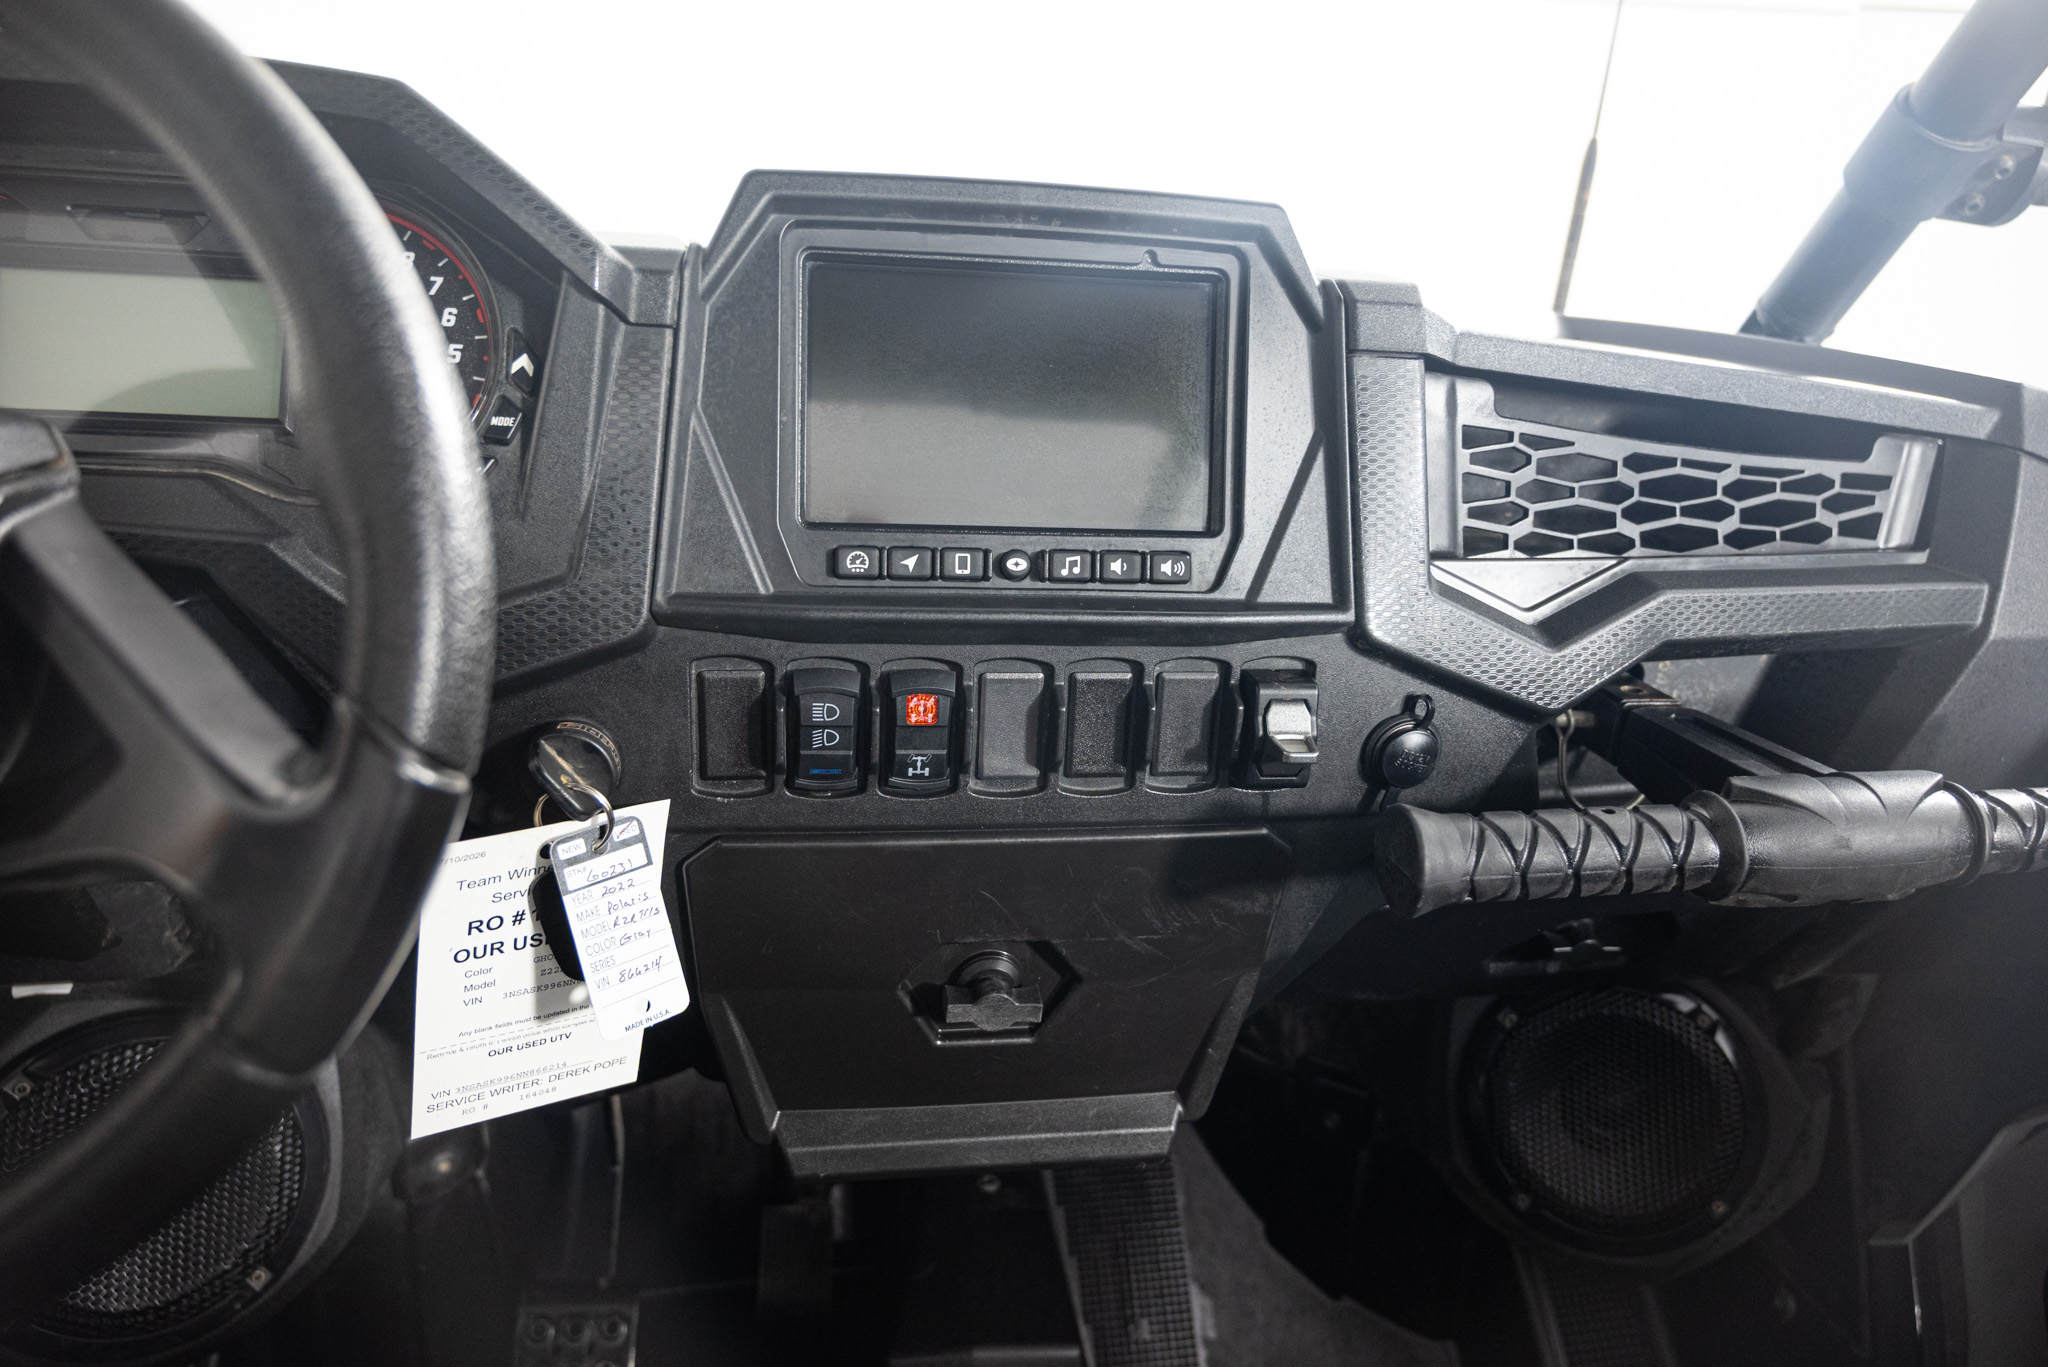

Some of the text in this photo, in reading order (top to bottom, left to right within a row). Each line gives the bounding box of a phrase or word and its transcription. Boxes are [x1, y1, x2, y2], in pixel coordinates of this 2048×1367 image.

[429, 276, 444, 296] 7
[442, 307, 458, 327] 6
[447, 343, 464, 364] 5
[490, 416, 516, 427] MODE
[562, 843, 582, 854] NEW
[586, 858, 633, 882] 60231
[456, 874, 502, 891] Team
[571, 878, 635, 905] YEAR 2022
[467, 915, 504, 936] RO
[512, 910, 526, 926] #
[576, 905, 601, 922] MAKE
[581, 921, 612, 939] MODEL
[453, 933, 550, 963] OUR US
[586, 929, 651, 956] COLOR Gray
[464, 953, 556, 979] Color GHO
[590, 955, 616, 974] SERIES
[595, 955, 662, 989] VIN 866214
[463, 966, 563, 993] Model Z22
[463, 996, 483, 1007] VIN
[458, 1030, 473, 1038] Any
[474, 1025, 493, 1034] blank
[495, 1020, 513, 1029] fields
[514, 1017, 532, 1025] must
[543, 1007, 571, 1019] updated
[579, 1003, 590, 1011] the
[625, 1009, 672, 1032] MADE IN U.S.A.
[488, 1032, 572, 1057] OUR USED UTV
[426, 1056, 627, 1113] SERVICE WRITER: DEREK POPE
[431, 1089, 451, 1100] VIN
[462, 1107, 476, 1115] RO
[519, 1086, 557, 1101] 164048
